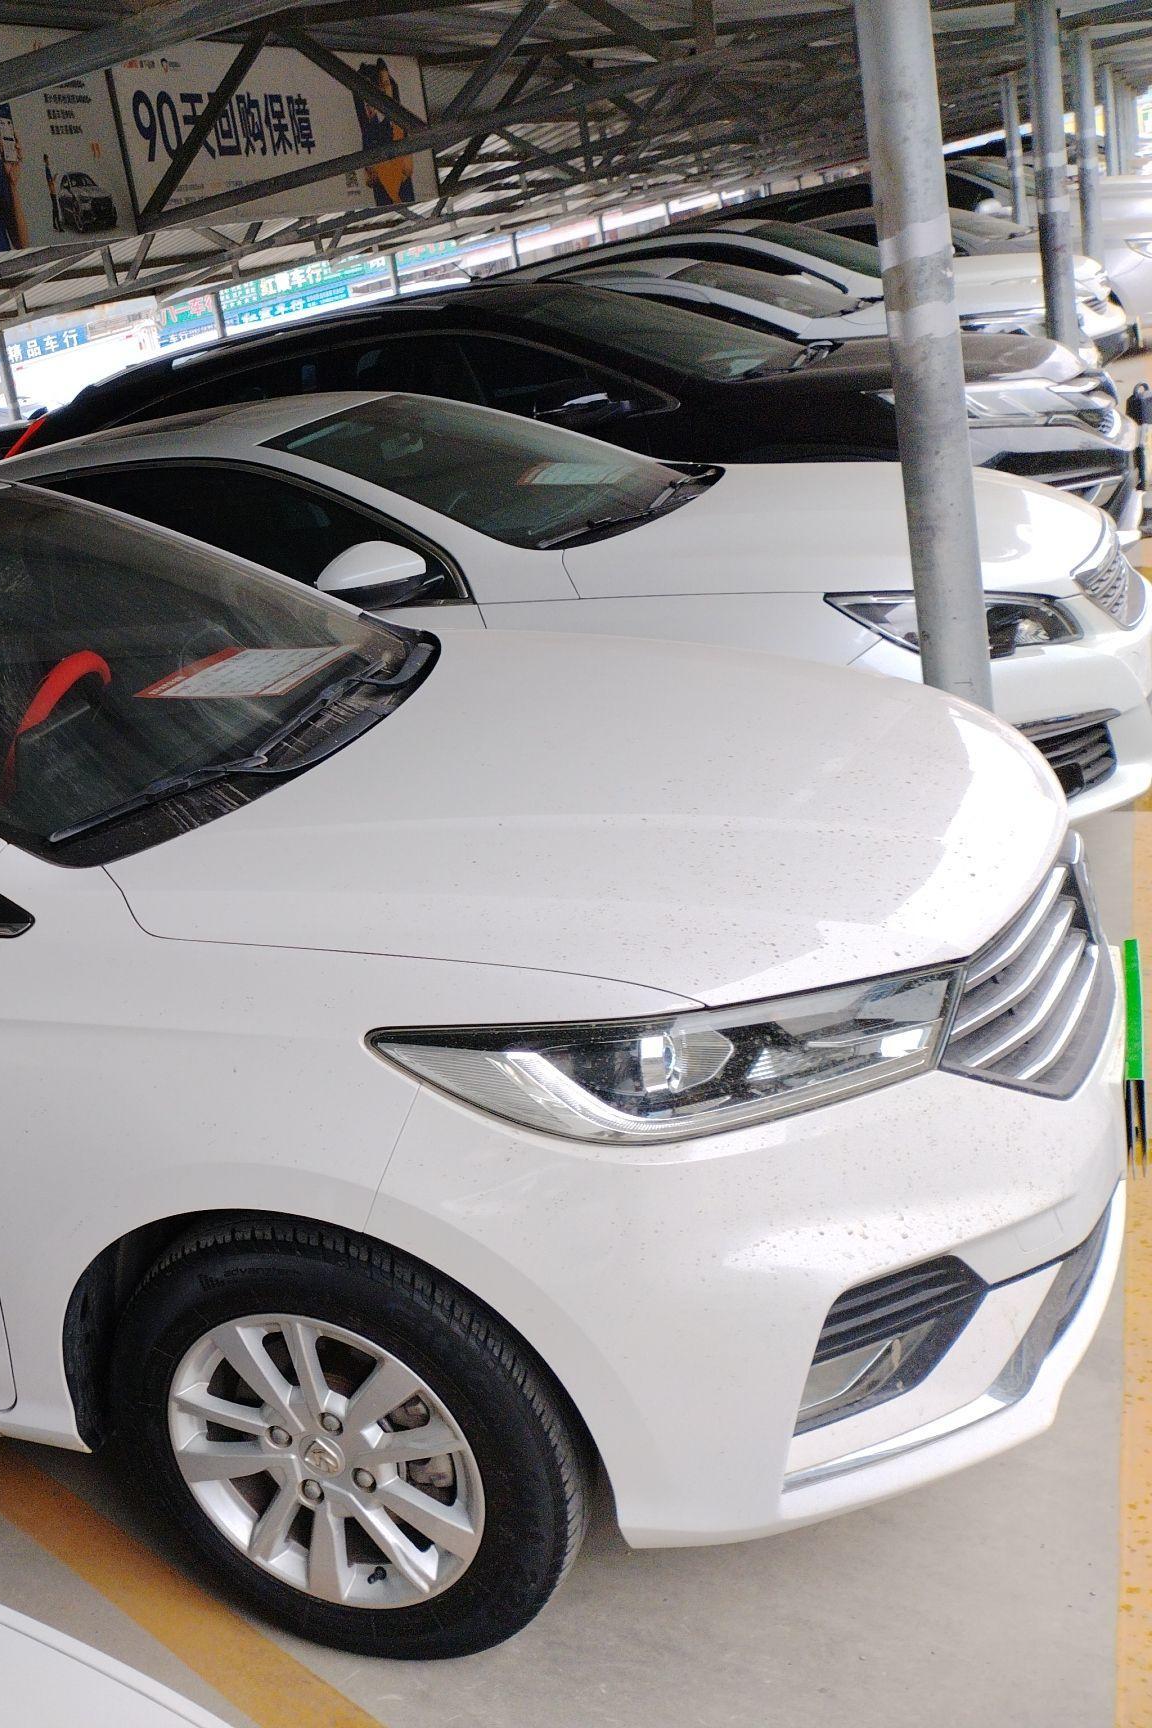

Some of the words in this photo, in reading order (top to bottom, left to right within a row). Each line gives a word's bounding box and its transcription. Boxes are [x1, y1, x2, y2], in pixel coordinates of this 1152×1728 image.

[132, 89, 317, 162] 90天回购保障
[7, 328, 79, 362] 精品车行
